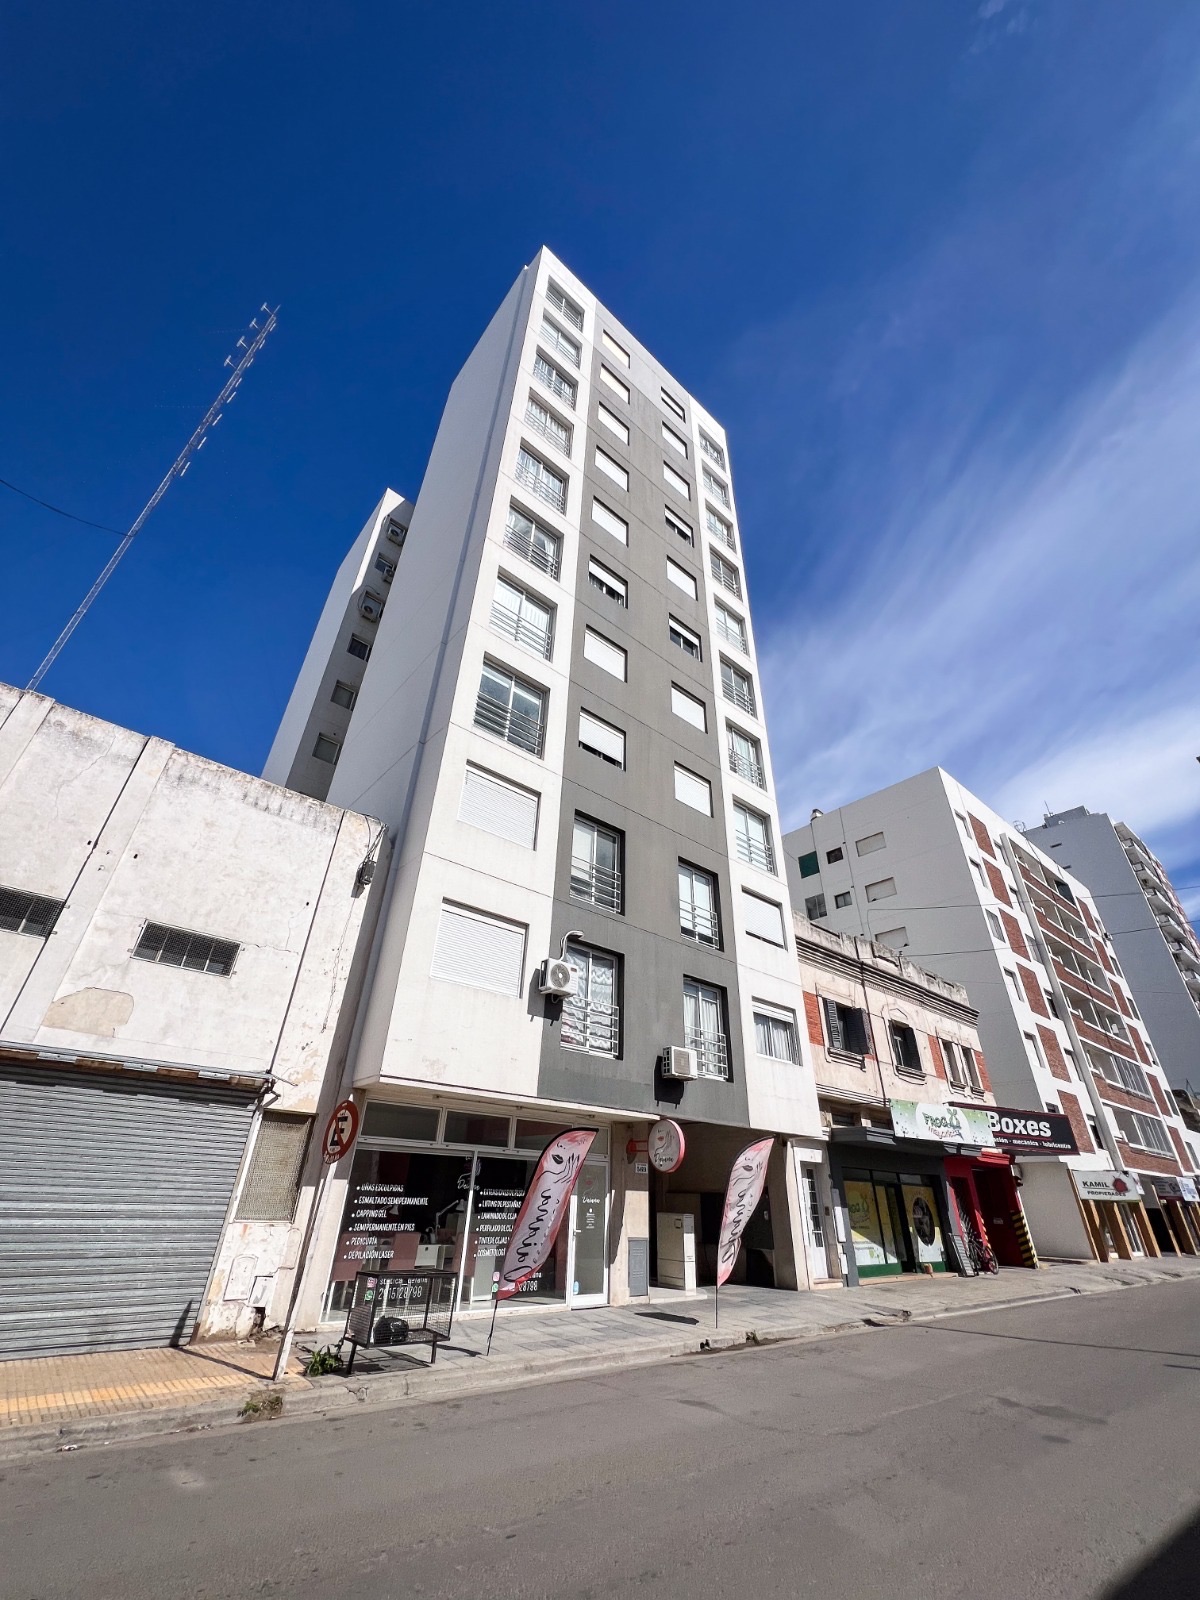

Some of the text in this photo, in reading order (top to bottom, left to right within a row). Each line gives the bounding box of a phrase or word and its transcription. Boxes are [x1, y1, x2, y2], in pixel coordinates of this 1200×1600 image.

[987, 1110, 1052, 1138] Boxes
[375, 1184, 404, 1192] ESCULPIDAS
[1082, 1180, 1110, 1188] KAMIL
[359, 1196, 429, 1206] ESMALTADO SEMIPERMANENTE
[356, 1209, 387, 1218] CAPPING GEL
[507, 1212, 517, 1220] CEJA
[353, 1223, 415, 1232] SEMIPERMANENTE EN PIES
[348, 1249, 378, 1259] DEPILACIÓN
